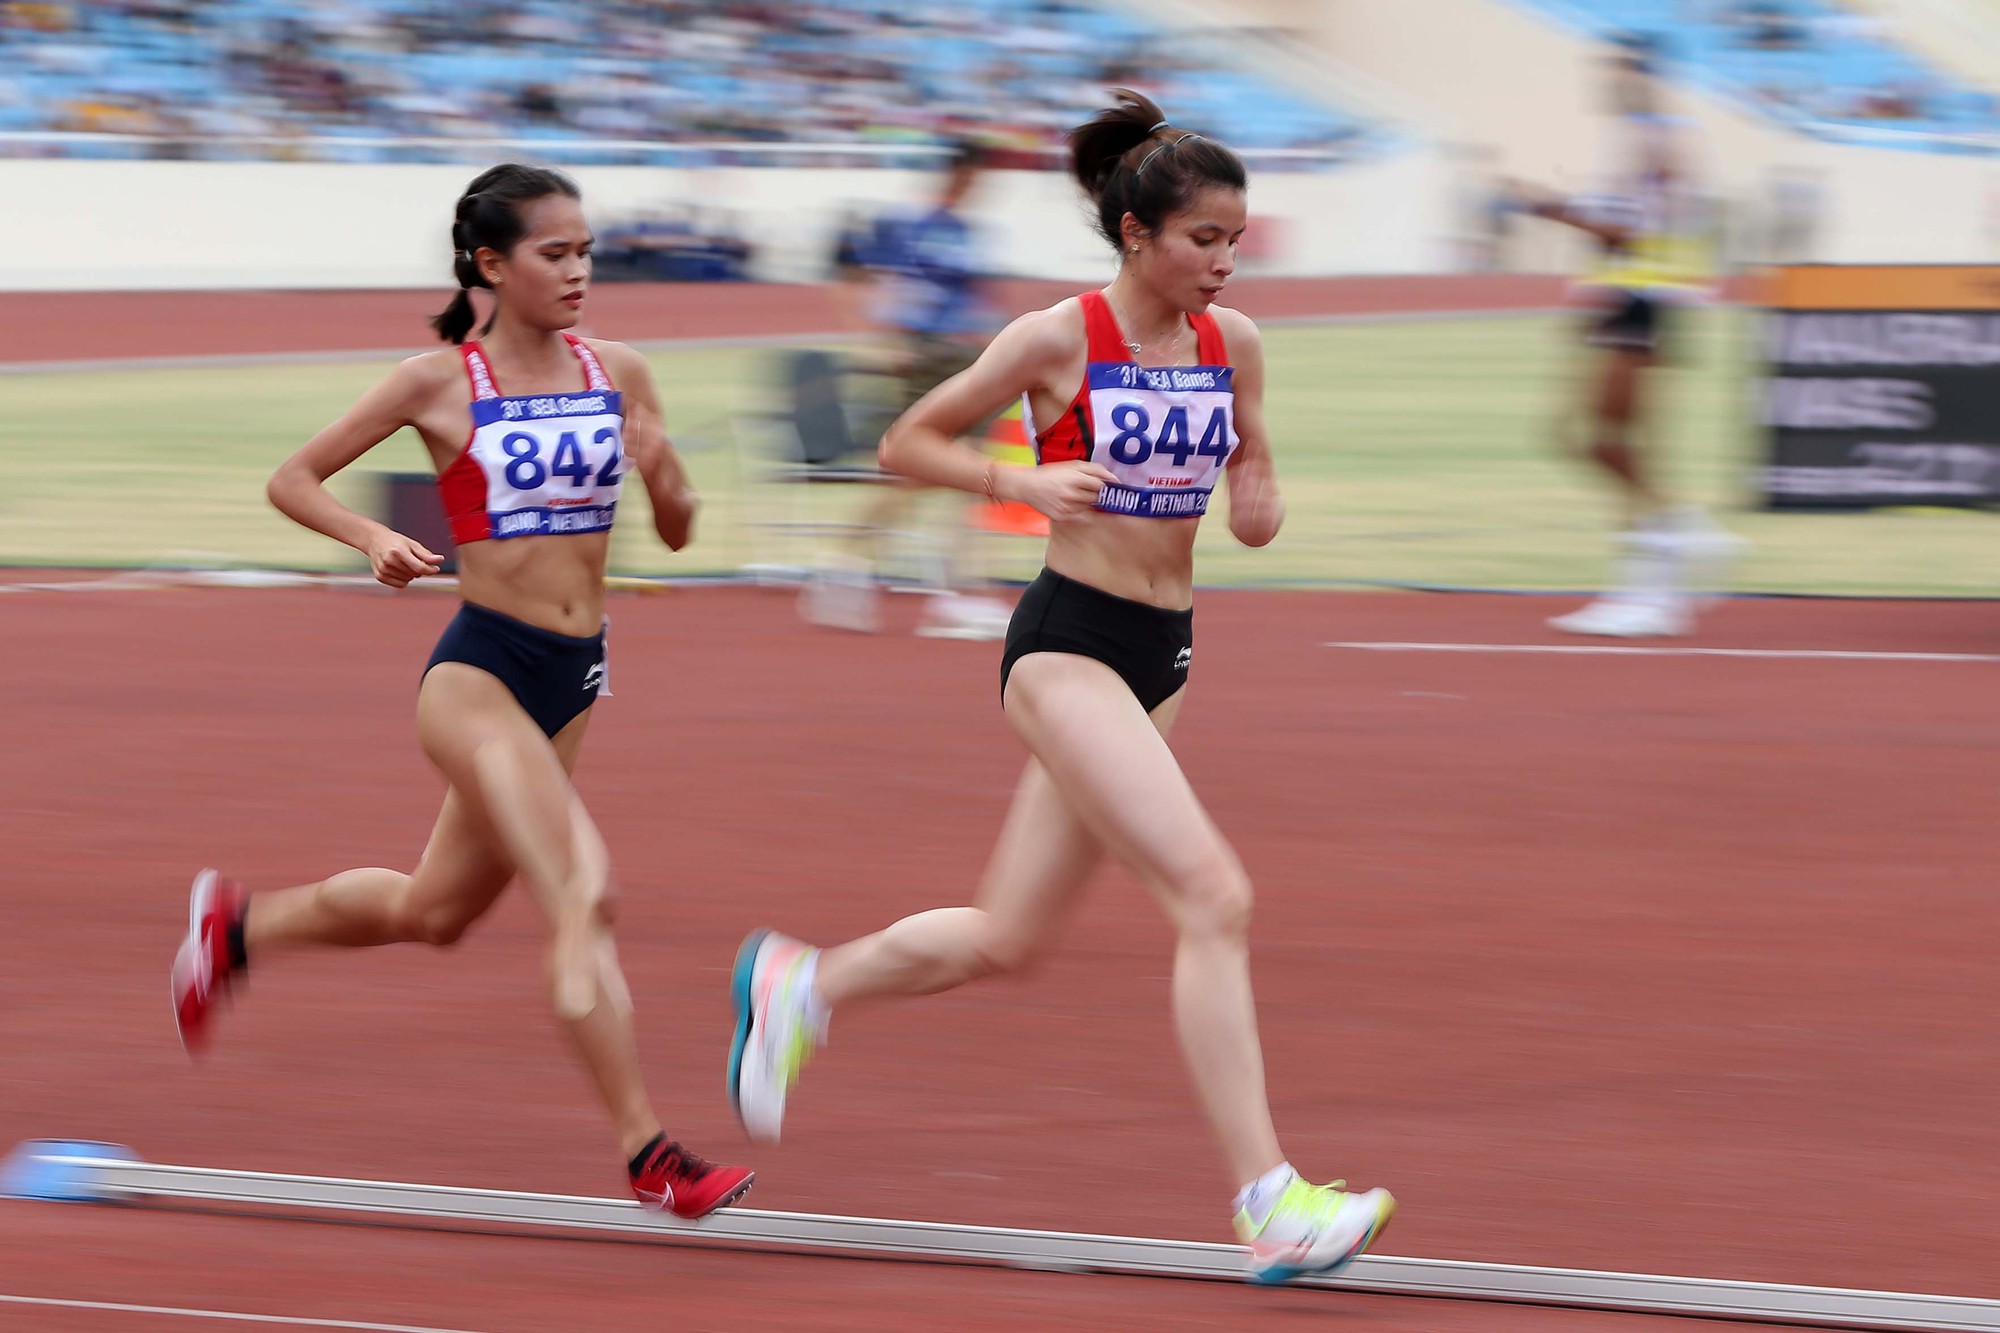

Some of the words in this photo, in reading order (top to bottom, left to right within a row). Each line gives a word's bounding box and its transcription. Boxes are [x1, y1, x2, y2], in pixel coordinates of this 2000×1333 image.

[1146, 370, 1172, 390] SEA
[1172, 370, 1216, 389] Games
[557, 395, 607, 416] Games
[1109, 402, 1230, 467] 844
[502, 427, 623, 490] 842
[1148, 476, 1193, 486] VIETNAM
[1097, 486, 1140, 512] HANOI
[1150, 492, 1197, 513] VIETNAM
